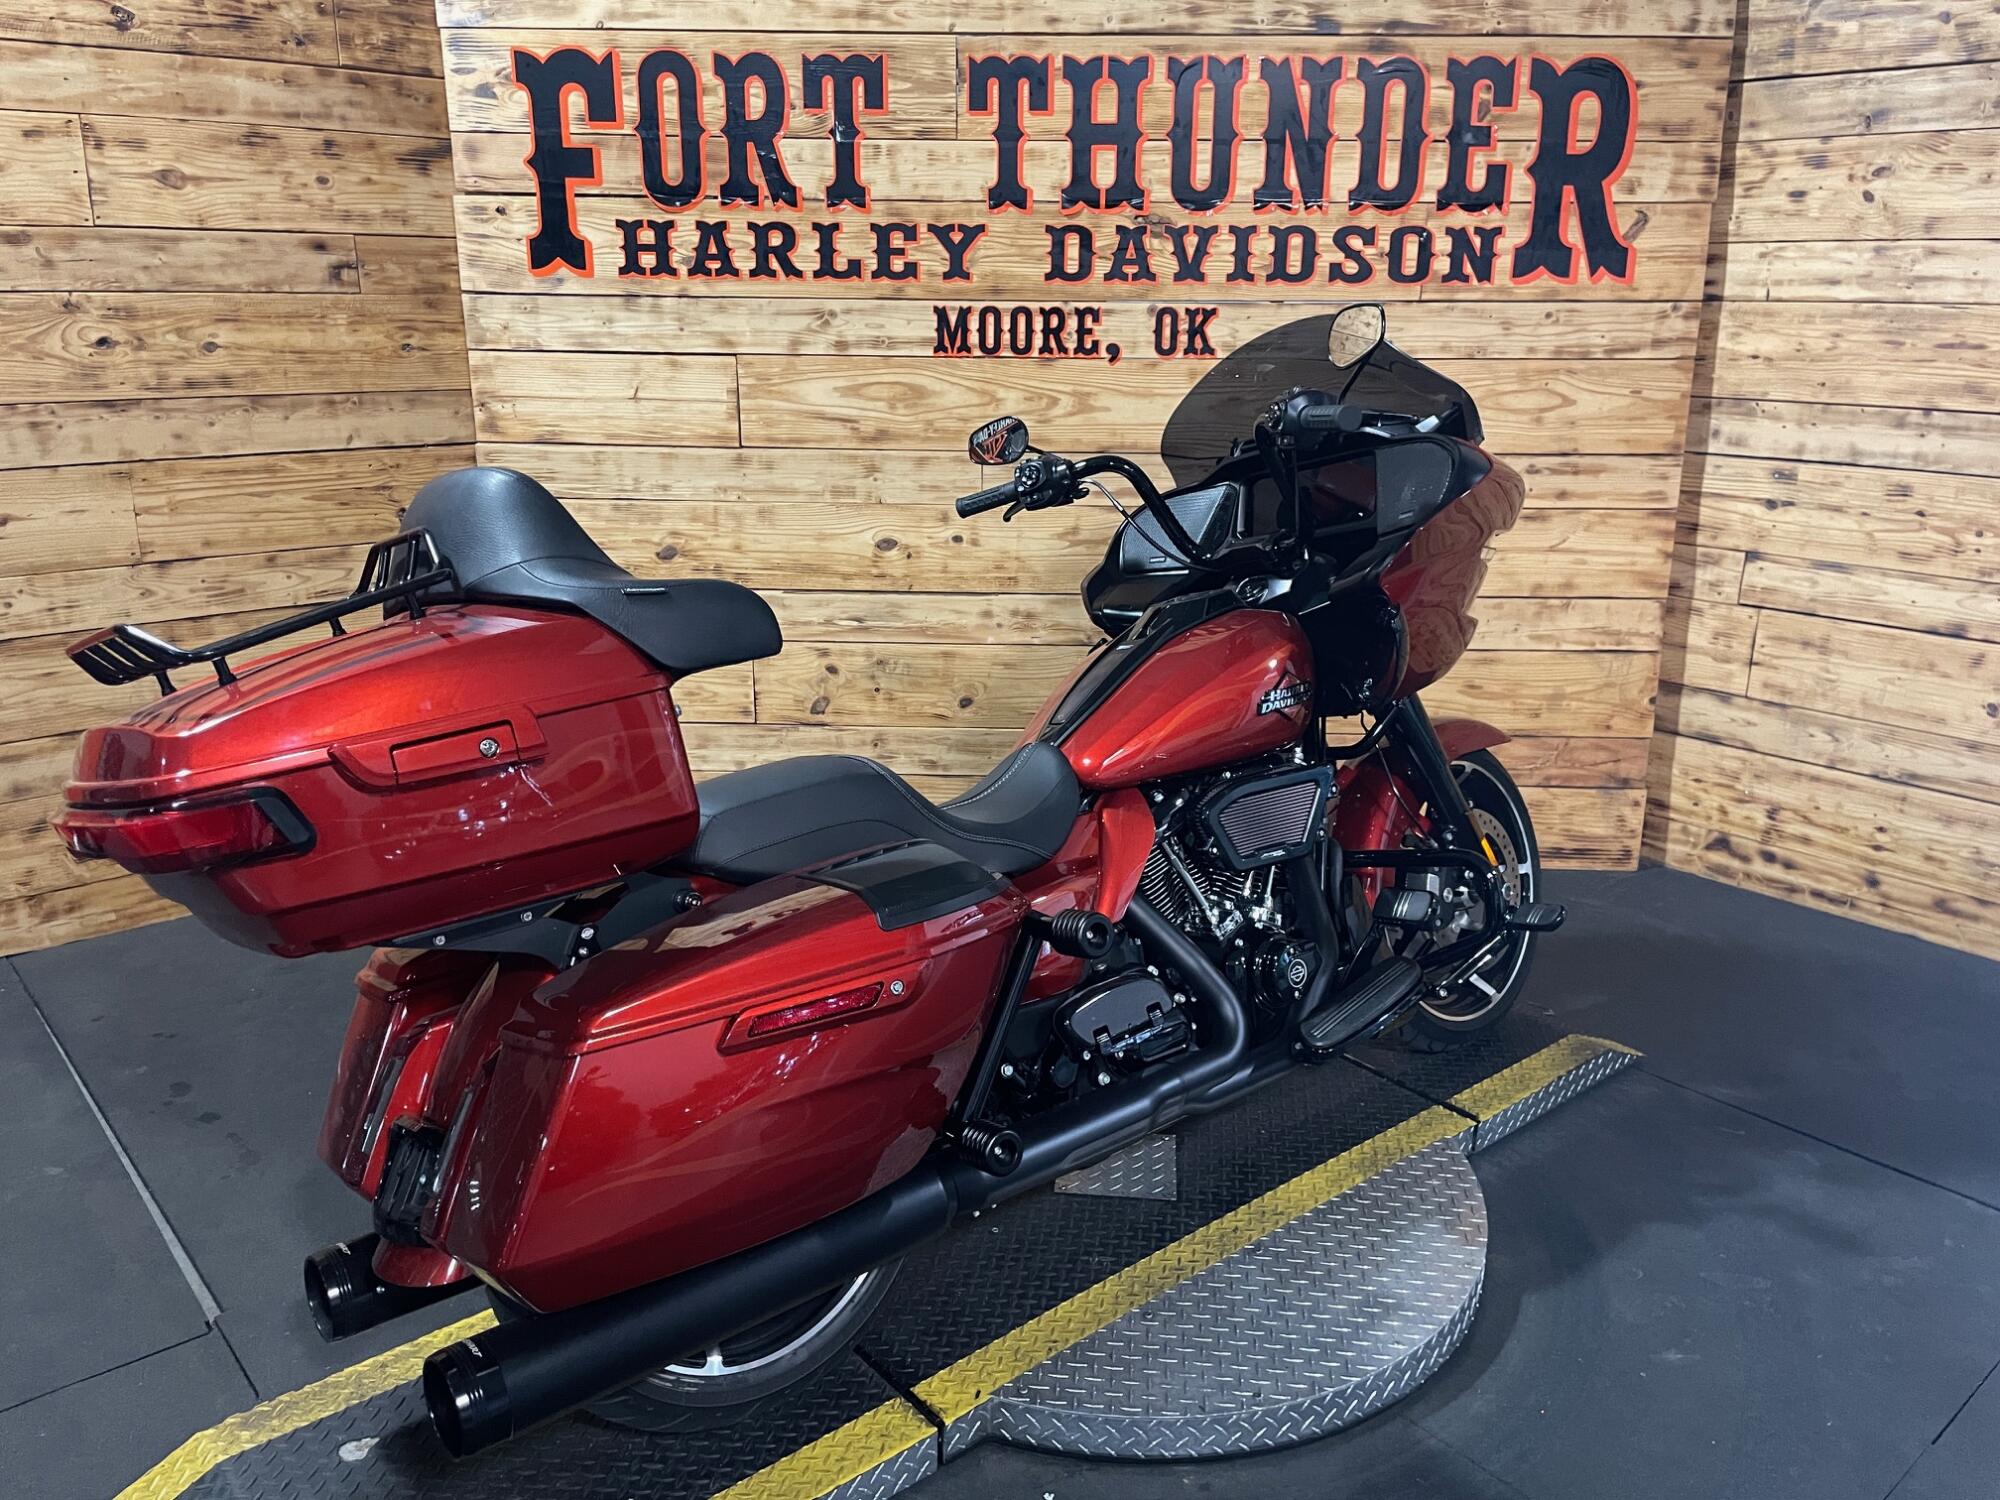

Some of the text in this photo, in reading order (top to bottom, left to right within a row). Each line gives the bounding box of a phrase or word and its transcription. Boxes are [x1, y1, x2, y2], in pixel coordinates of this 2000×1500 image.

[511, 44, 1637, 285] FORT THUNDER
[615, 219, 1503, 286] HARLEY DAVIDSON
[933, 306, 1217, 365] MOORE, OK
